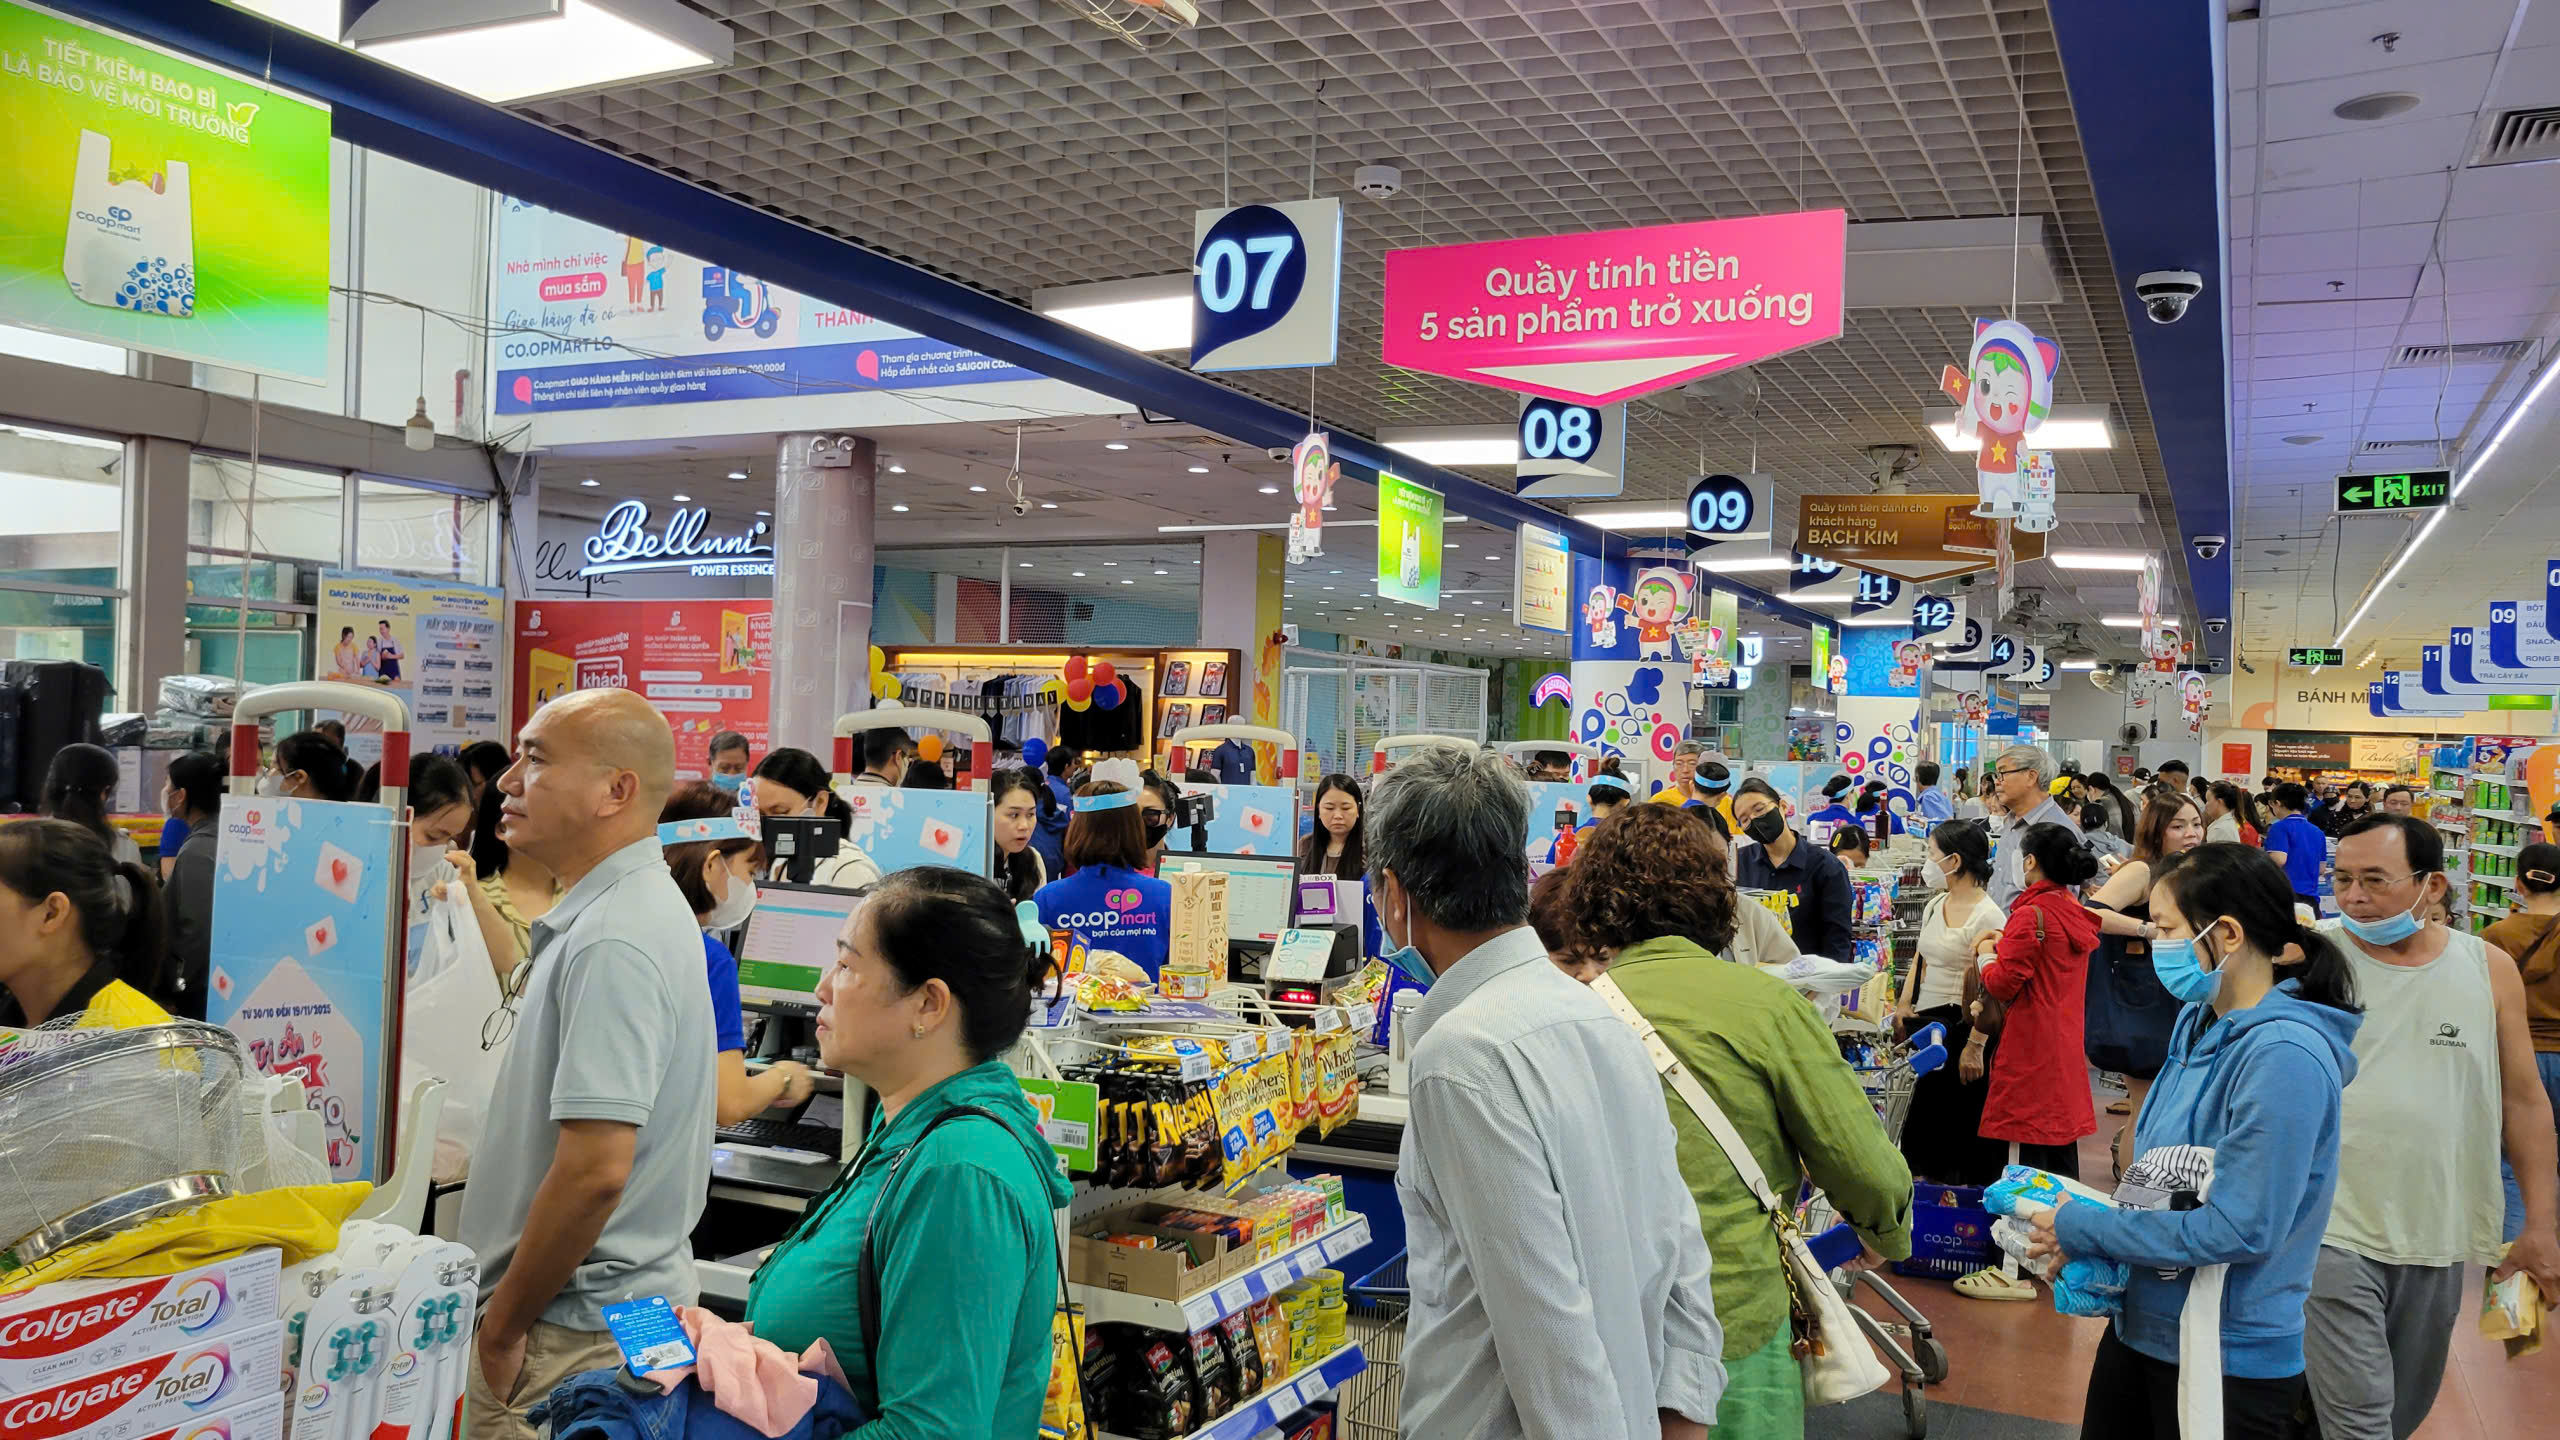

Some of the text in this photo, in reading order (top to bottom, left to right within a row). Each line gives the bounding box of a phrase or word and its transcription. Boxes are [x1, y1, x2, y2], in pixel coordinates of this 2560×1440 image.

[43, 36, 217, 109] TIẾT KIỆM BAO BÌ
[2, 53, 250, 145] LÀ BẢO VỆ MÔI TRƯỜNG
[507, 251, 608, 275] Nhà mình chỉ việc
[1200, 235, 1293, 313] 07
[1485, 247, 1740, 300] Quầy tính tiền
[545, 275, 602, 297] mua sắm
[504, 303, 617, 336] Giao hàng đã có
[1420, 283, 1813, 343] 5 sản phẩm trở xuống
[881, 354, 905, 364] Tham
[905, 353, 920, 364] gia
[920, 351, 952, 362] chương
[880, 360, 990, 379] Hấp dẫn nhất của SAIGON
[533, 378, 571, 390] Co.opmart
[570, 377, 589, 387] GIAO
[589, 373, 612, 386] HÀNG
[611, 370, 631, 383] MIỄN
[631, 370, 645, 382] PHÍ
[645, 370, 660, 381] bán
[660, 369, 677, 380] kính
[533, 391, 555, 402] Thông
[555, 390, 565, 400] tin
[565, 390, 577, 400] chi
[577, 388, 590, 399] tiết
[590, 388, 604, 398] liên
[614, 386, 633, 396] nhân
[633, 384, 650, 395] viên
[669, 383, 686, 394] giao
[686, 381, 707, 392] hàng
[1524, 407, 1592, 458] 08
[2412, 483, 2446, 497] EXIT
[1690, 490, 1747, 532] 09
[1809, 501, 1930, 515] Quầy tính tiền dành cho
[1809, 515, 1877, 529] khách hàng
[1807, 529, 1899, 548] BẠCH KIM
[691, 563, 775, 577] POWER ESSENCE
[350, 590, 388, 603] NGUYÊN
[1860, 575, 1889, 601] 11
[1916, 602, 1950, 627] 12
[2491, 608, 2516, 624] 09
[2526, 604, 2544, 612] BỘT
[2451, 632, 2472, 646] 10
[2324, 653, 2341, 662] EXIT
[2423, 650, 2441, 662] 11
[582, 672, 629, 688] khách
[2384, 675, 2399, 685] 12
[2479, 671, 2497, 680] TRÁI
[2497, 672, 2512, 680] CÂY
[2297, 687, 2346, 704] BÁNH
[2370, 685, 2383, 694] 13
[1091, 928, 1157, 938] bạn của mọi nhà
[242, 1002, 332, 1020] TỪ 30/10 ĐẾN 19/11/2025
[1151, 1090, 1214, 1147] RIESEN
[443, 1269, 474, 1284] 2 PACK
[150, 1290, 212, 1325] Total
[359, 1296, 391, 1312] 2 PACK
[0, 1295, 140, 1348] Colgate
[131, 1312, 205, 1337] ACTIVE PREVENTION
[32, 1357, 79, 1376] CLEAN MINT
[154, 1364, 216, 1401] Total
[4, 1373, 145, 1429] Colgate
[137, 1387, 209, 1414] ACTIVE PREVENTION
